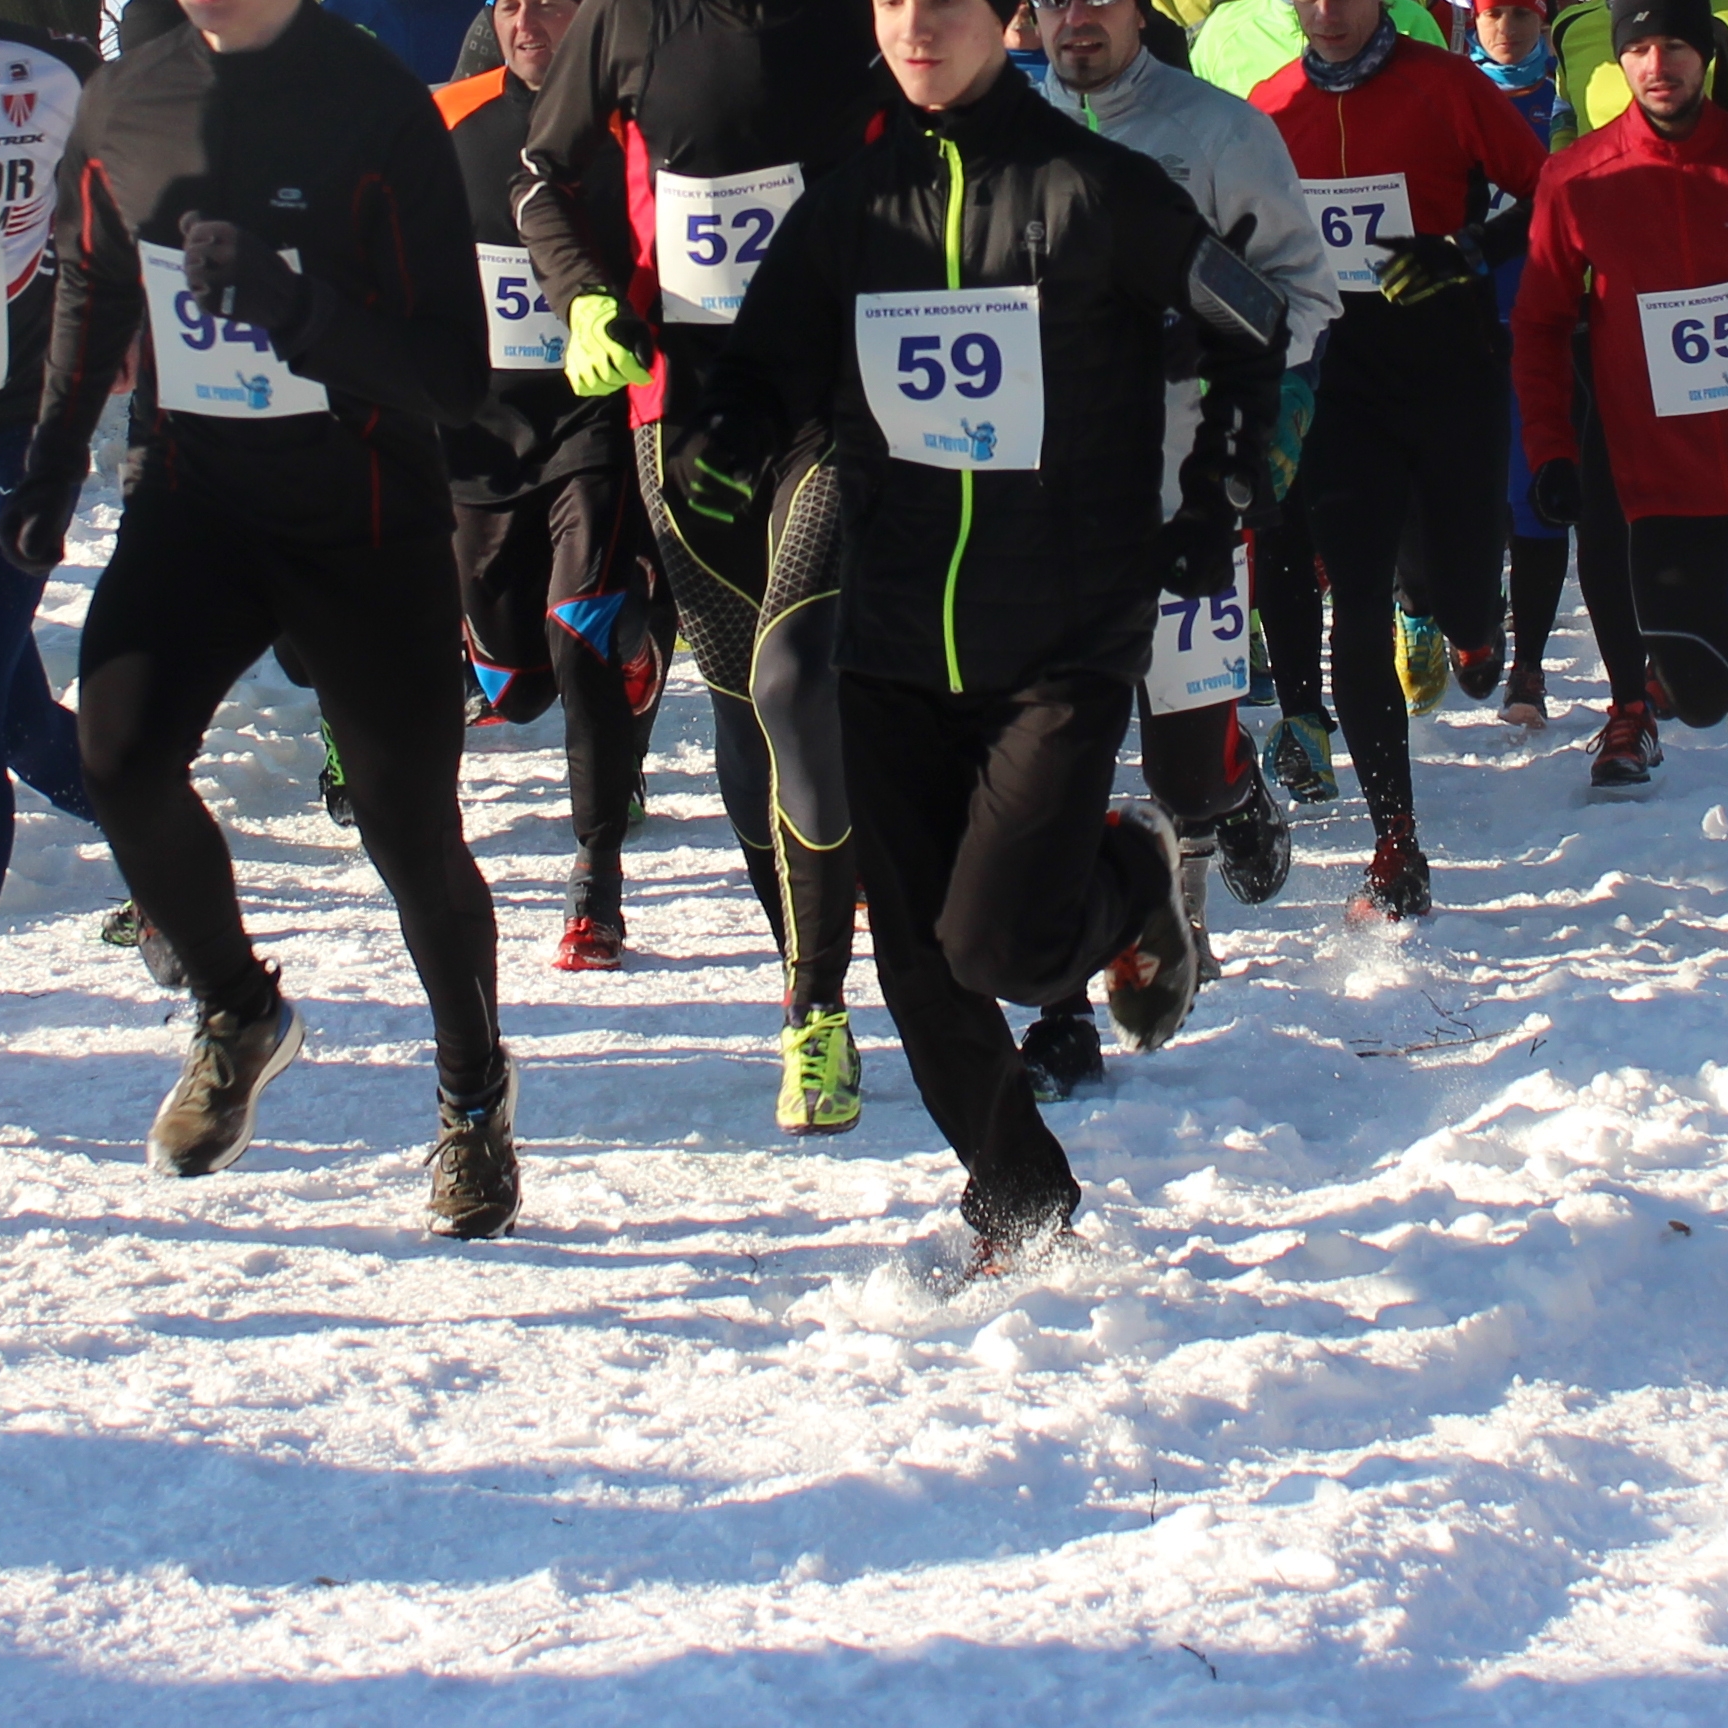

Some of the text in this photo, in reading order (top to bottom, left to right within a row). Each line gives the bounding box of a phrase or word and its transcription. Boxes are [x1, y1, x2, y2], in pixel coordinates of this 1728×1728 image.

[687, 208, 775, 266] 52
[1321, 203, 1385, 248] 67
[174, 290, 270, 353] 94
[897, 332, 1002, 401] 59
[1159, 585, 1244, 652] 75
